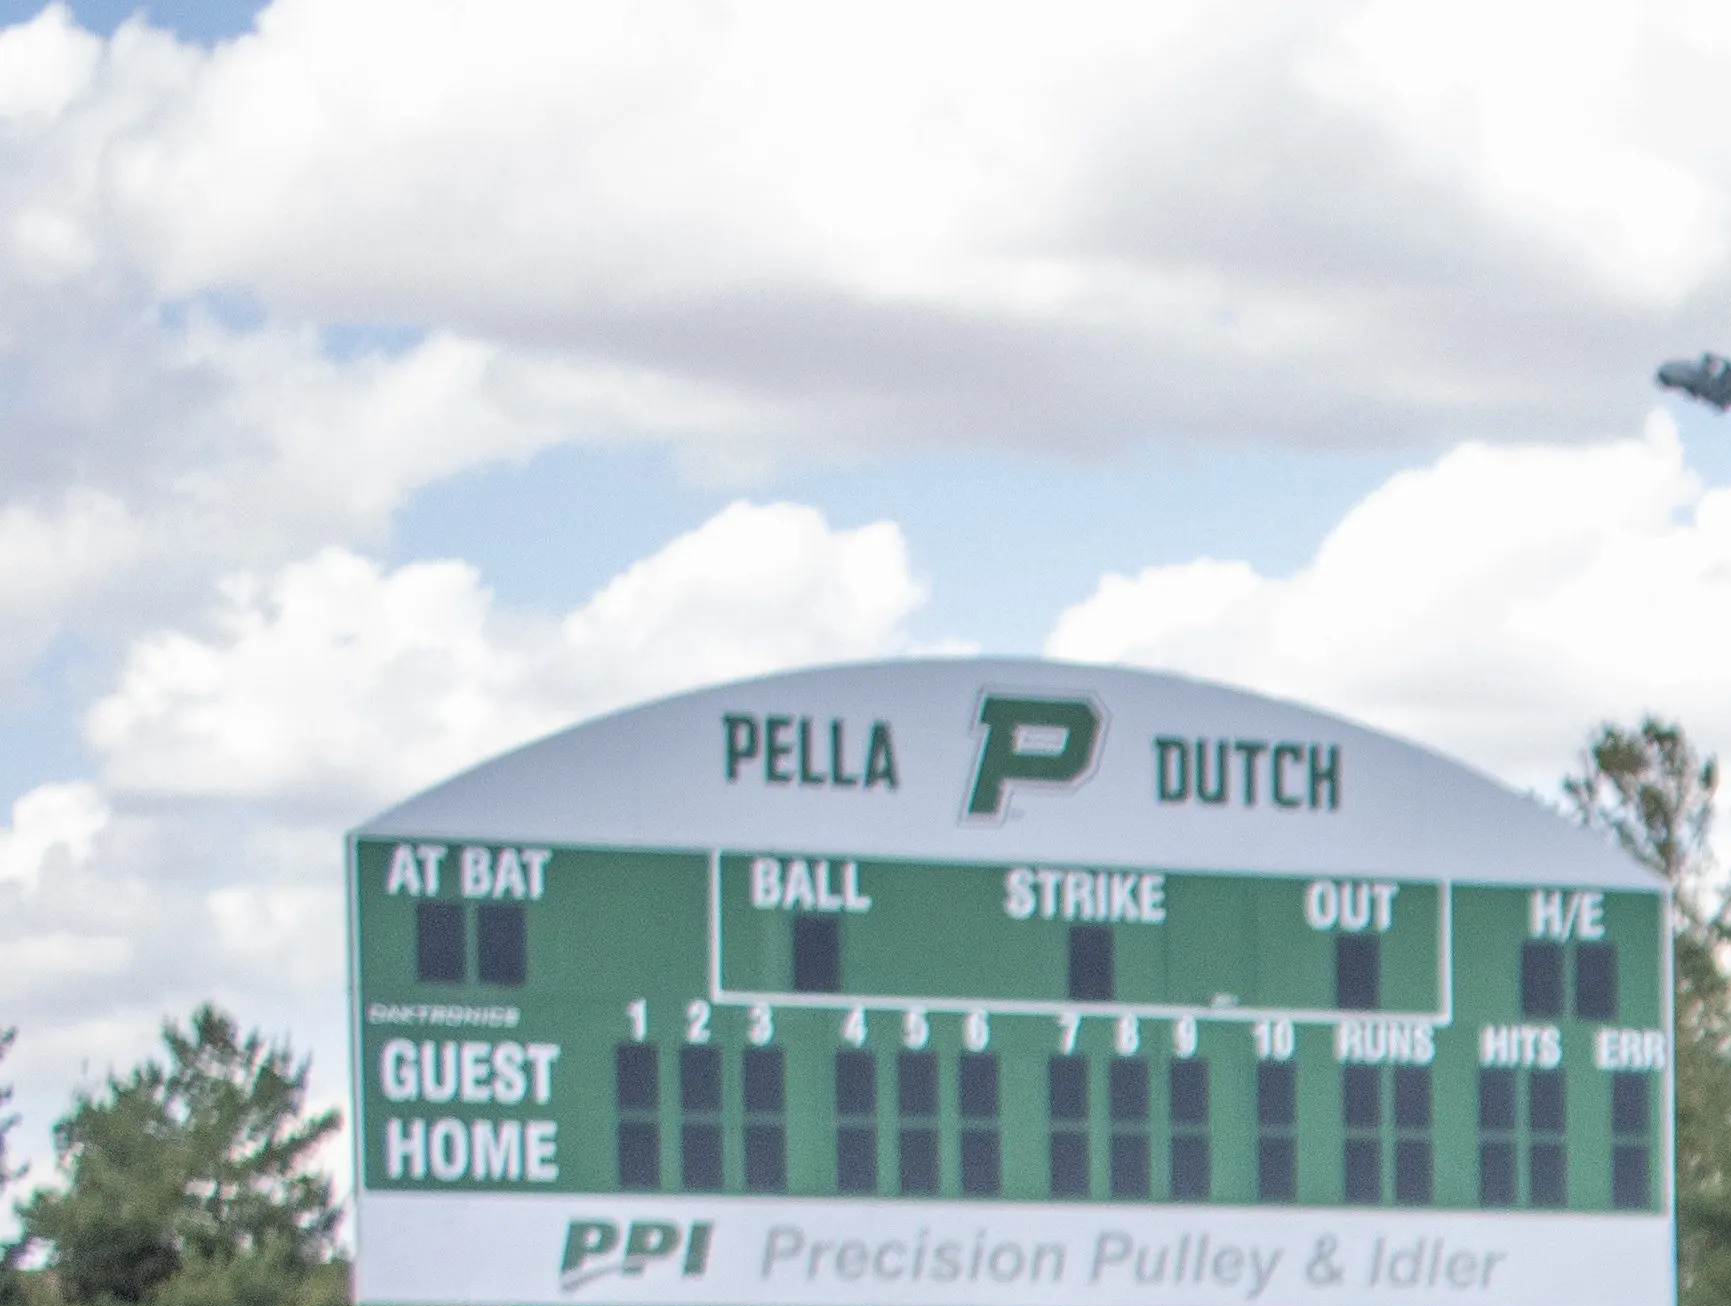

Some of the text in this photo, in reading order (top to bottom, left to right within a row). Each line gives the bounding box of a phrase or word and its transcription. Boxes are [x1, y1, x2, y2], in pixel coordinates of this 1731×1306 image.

[722, 692, 1343, 818] PELLA P DUTCH
[387, 845, 552, 901] AT BAT
[749, 858, 872, 914] BALL
[1004, 867, 1167, 924] STRIKE
[1306, 881, 1399, 931] OUT
[1529, 889, 1605, 940] H/E
[624, 999, 1665, 1069] 1 2 3 4 5 6 7 8 9 10 RUNS HITS ERR
[380, 1039, 560, 1104] GUEST
[387, 1118, 558, 1181] HOME
[560, 1218, 715, 1280] PPI
[760, 1224, 1506, 1301] Precision Pulley & Idler
